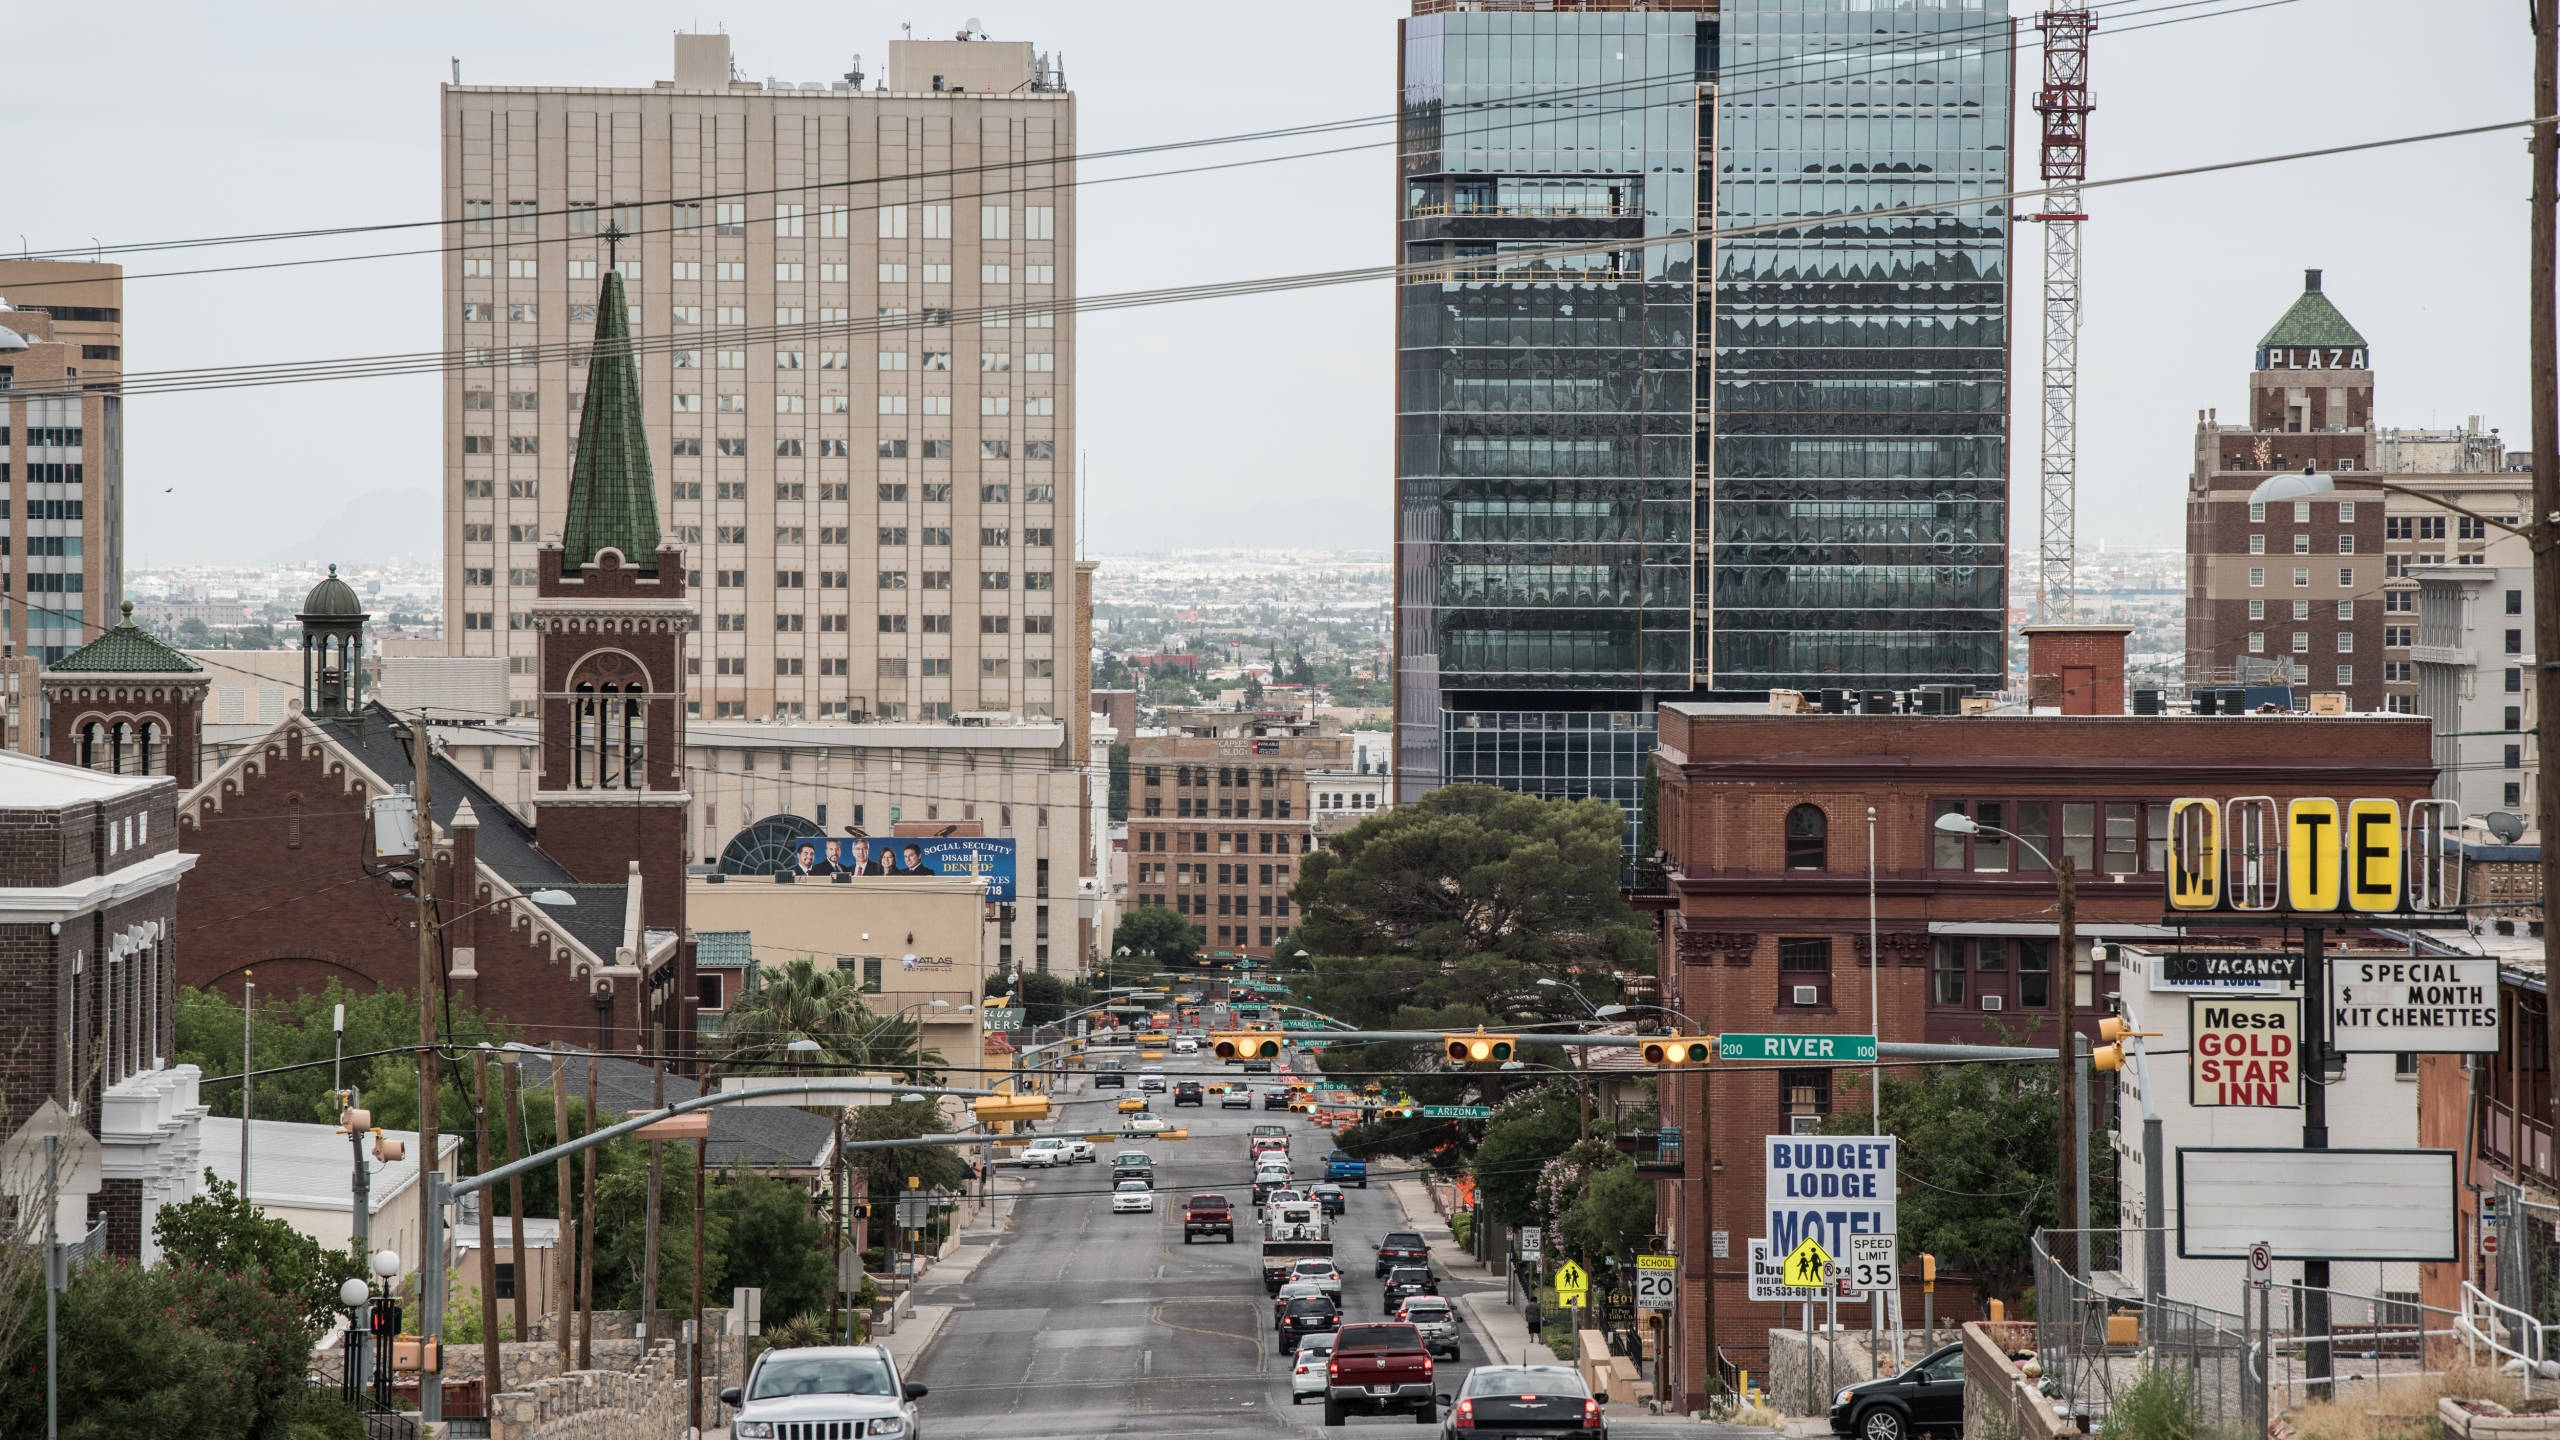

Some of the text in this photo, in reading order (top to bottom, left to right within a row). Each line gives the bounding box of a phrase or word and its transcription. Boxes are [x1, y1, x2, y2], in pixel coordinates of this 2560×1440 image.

[2269, 348, 2364, 369] PLAZA
[924, 841, 1012, 855] SOCIAL SECURITY
[941, 854, 995, 862] DISABIITY
[943, 863, 994, 872] DENID?
[918, 957, 953, 965] ATLAS
[2206, 959, 2295, 974] VACANCY
[2361, 964, 2461, 982] SPECIAL
[2408, 986, 2482, 1005] MONTH
[2205, 1007, 2285, 1029] Mesa
[1722, 1038, 1875, 1057] 200 RIVER 100
[2198, 1033, 2292, 1057] GOLD
[2201, 1060, 2290, 1083] STAR
[2218, 1082, 2278, 1106] INN
[1437, 1107, 1478, 1116] ARIZONA
[1773, 1143, 1890, 1170] BUDGET
[1786, 1173, 1877, 1198] LODGE
[1524, 1239, 1539, 1248] 35
[1854, 1239, 1893, 1249] SPEED
[1640, 1259, 1673, 1268] SCHOOL
[1858, 1251, 1888, 1261] LIMIT
[1756, 1277, 1771, 1285] FREE
[1857, 1264, 1892, 1285] 35
[1640, 1277, 1673, 1296] 20
[1756, 1286, 1816, 1297] 915-533-681
